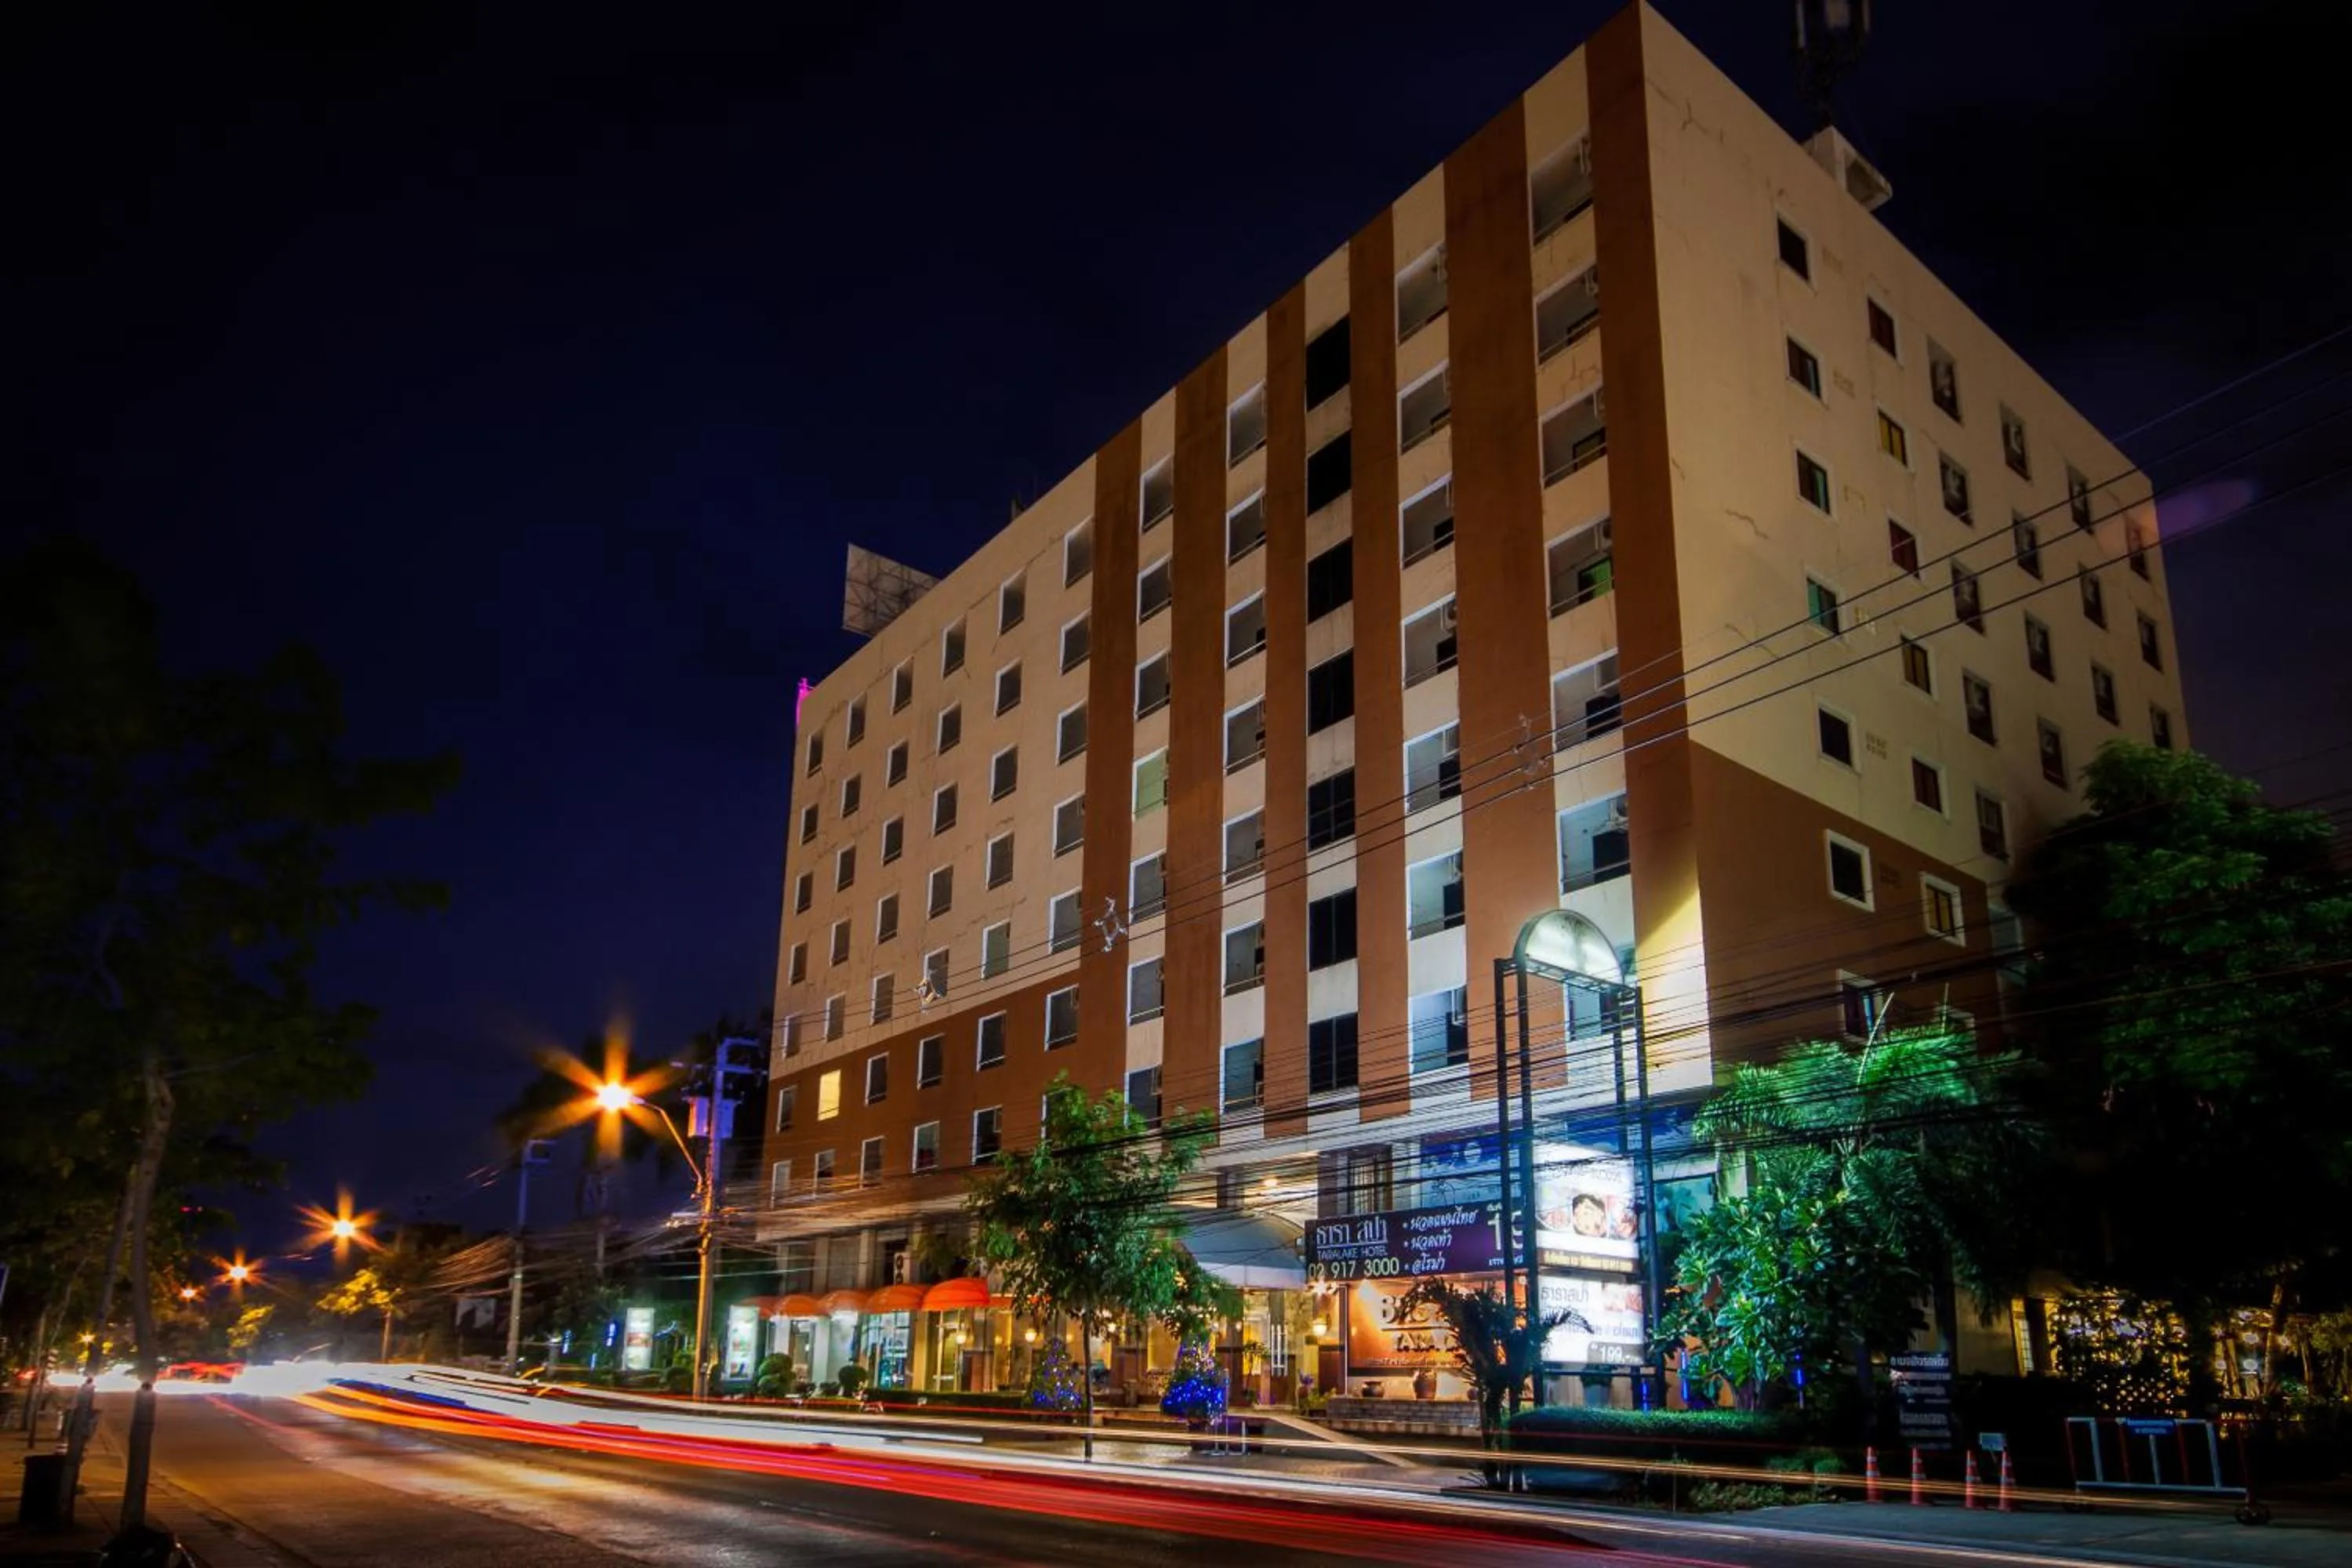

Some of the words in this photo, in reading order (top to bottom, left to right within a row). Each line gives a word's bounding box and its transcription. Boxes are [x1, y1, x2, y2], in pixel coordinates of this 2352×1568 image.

[1357, 1216, 1388, 1243] สปา
[1361, 1244, 1388, 1257] HOTEL
[1308, 1262, 1325, 1280] 02
[1331, 1260, 1357, 1279] 917
[1363, 1256, 1400, 1277] 3000
